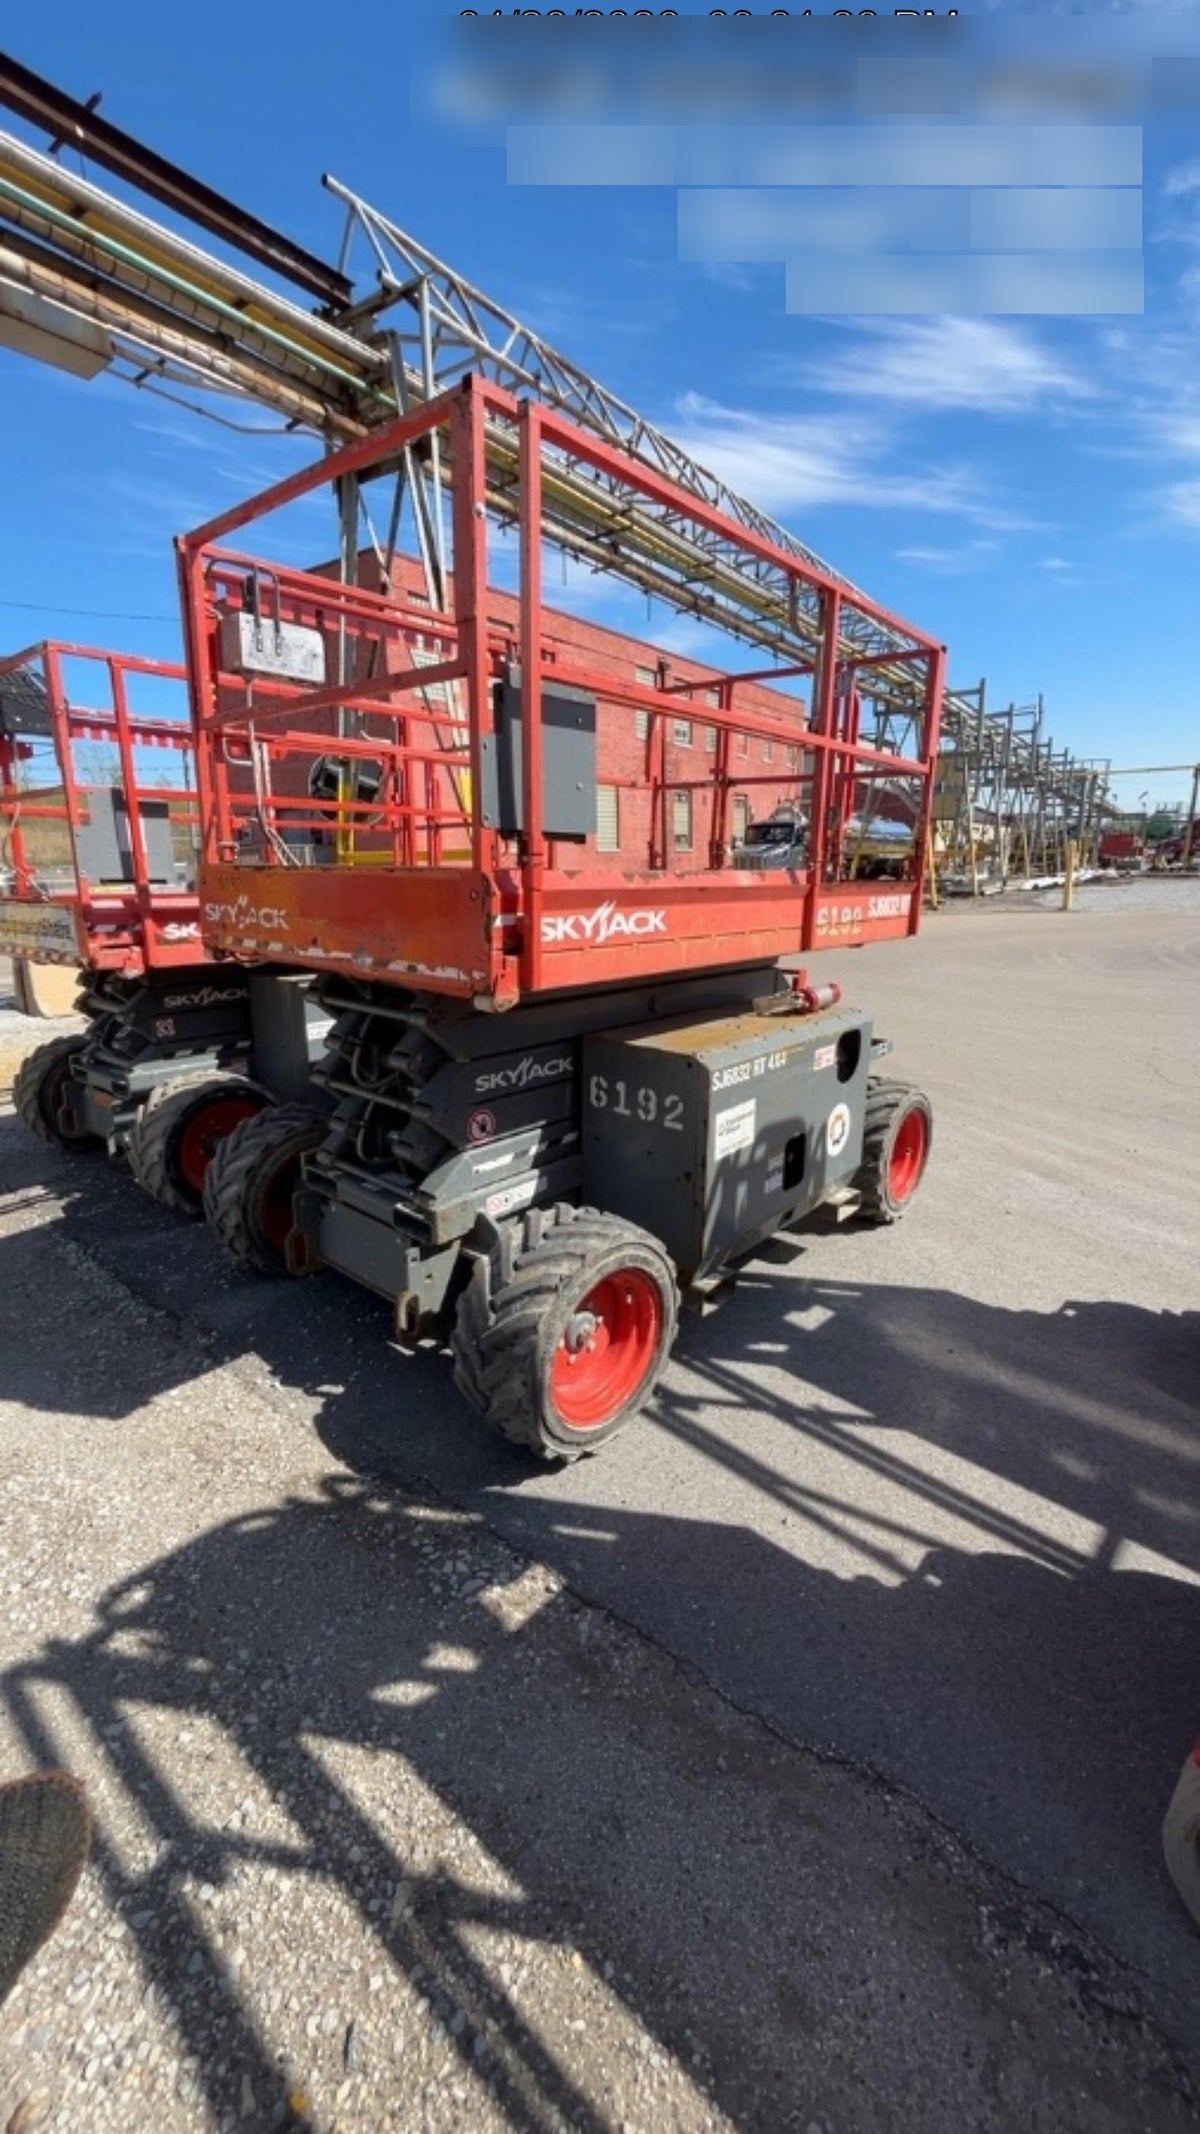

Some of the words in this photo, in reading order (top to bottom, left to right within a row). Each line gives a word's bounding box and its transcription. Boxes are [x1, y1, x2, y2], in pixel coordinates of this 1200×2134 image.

[540, 900, 667, 943] SKYJACK
[163, 986, 249, 1008] SKYJACK
[475, 1057, 573, 1092] SKYJACK
[589, 1075, 684, 1131] 6192
